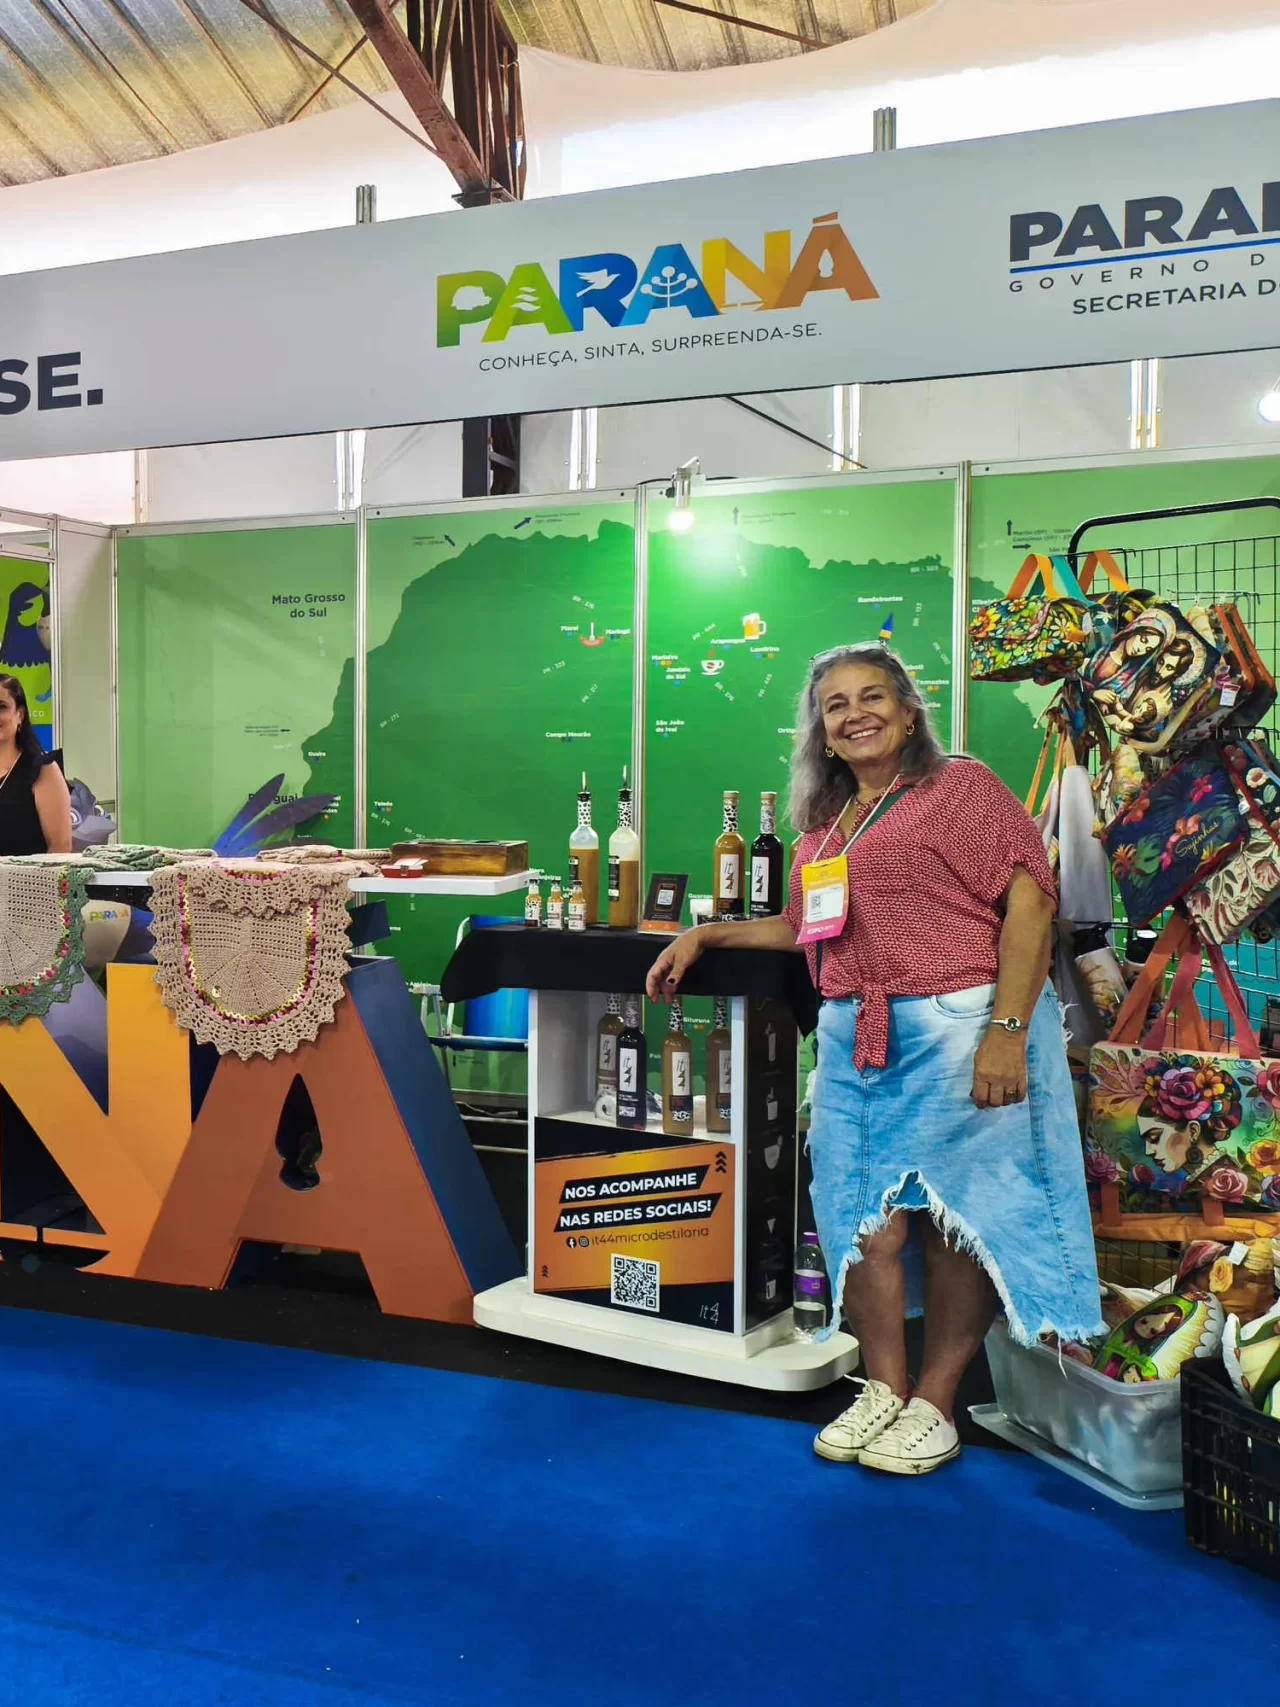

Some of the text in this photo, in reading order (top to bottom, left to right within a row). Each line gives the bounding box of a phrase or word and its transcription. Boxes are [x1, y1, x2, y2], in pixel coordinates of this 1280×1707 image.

[436, 211, 880, 348] PARANÁ
[1009, 259, 1209, 293] GOVERNO
[1072, 281, 1247, 314] SECRETARIA
[479, 322, 823, 372] CONHEÇA, SINTA, SURPREENDA-SE.
[272, 593, 346, 605] Mato Grosso
[289, 607, 327, 618] do Sul
[565, 1172, 698, 1199] NOS ACOMPANHE
[560, 1199, 712, 1228] NAS REDES SOCIAIS!
[591, 1226, 709, 1246] it44microdestilaria
